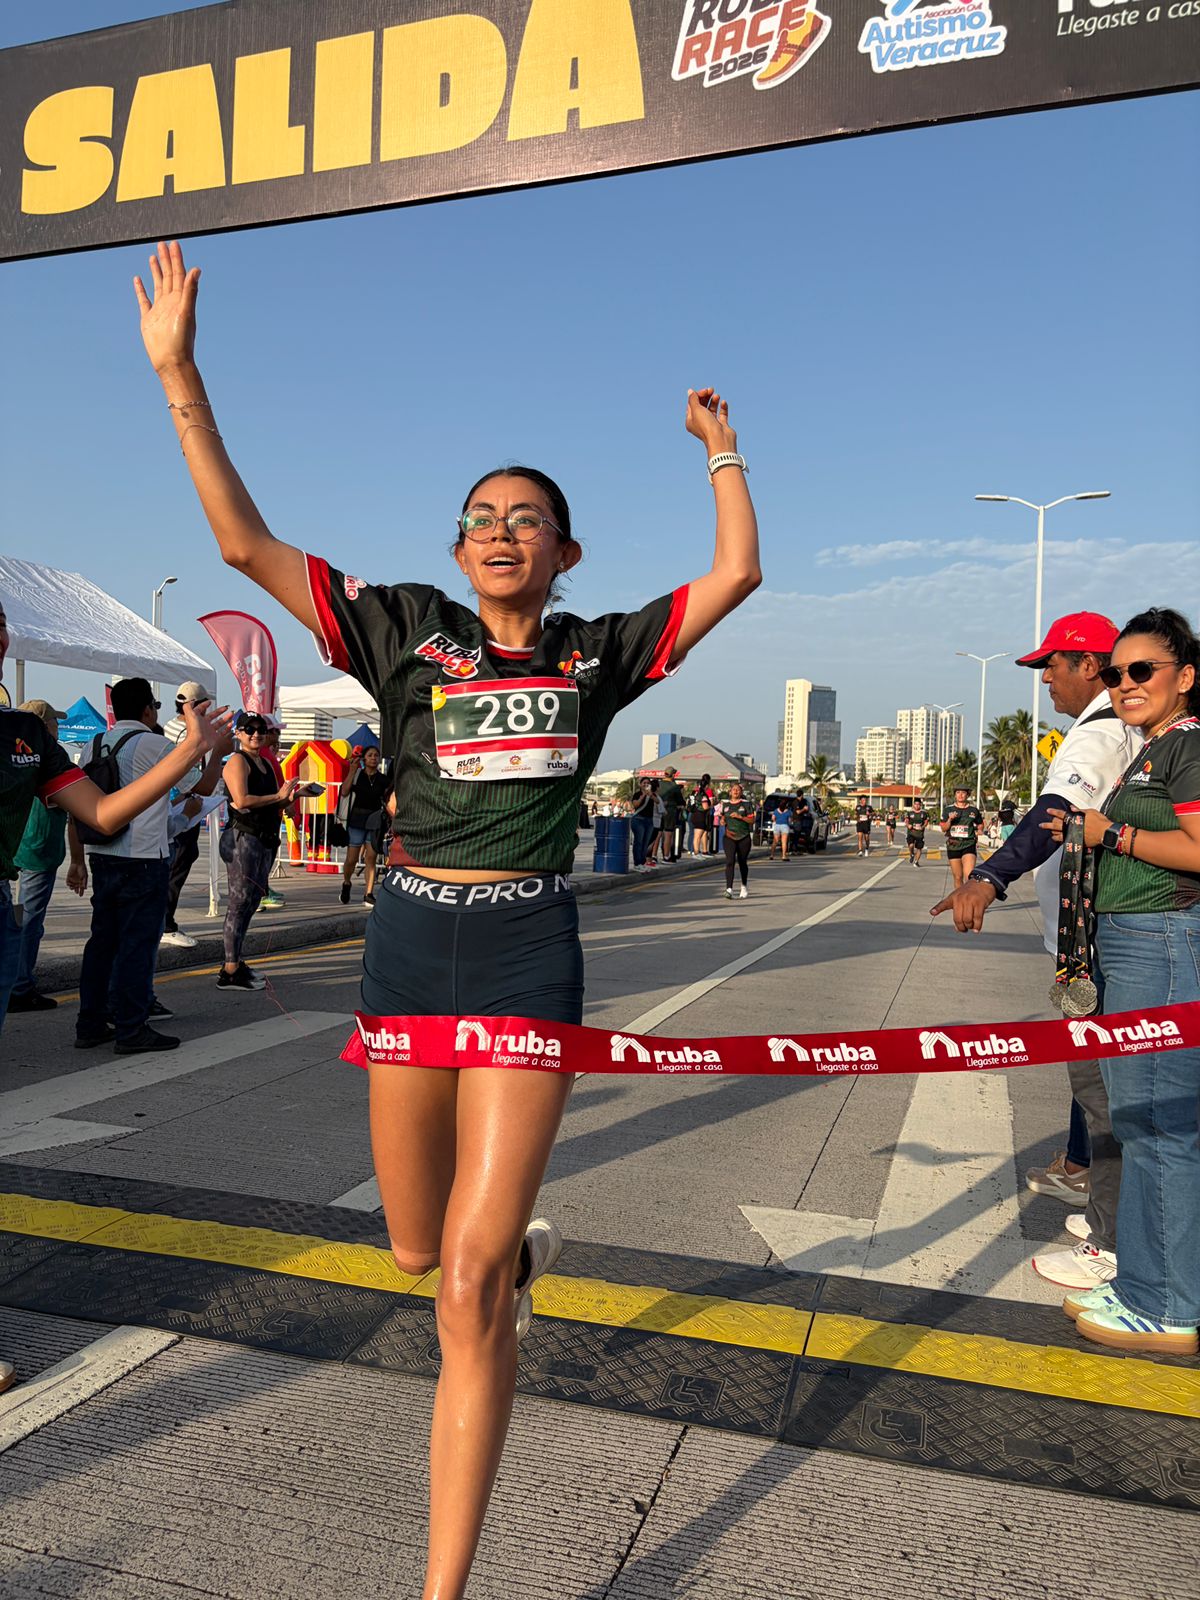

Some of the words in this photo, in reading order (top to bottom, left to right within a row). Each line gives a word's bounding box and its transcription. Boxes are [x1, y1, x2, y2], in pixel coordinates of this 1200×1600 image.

[686, 0, 780, 37] RU
[864, 11, 987, 47] Autismo
[1057, 9, 1140, 37] Llegaste
[1146, 6, 1161, 22] a
[1167, 0, 1200, 19] cas
[678, 0, 808, 75] RACE
[875, 32, 1000, 67] Veracruz
[708, 45, 769, 82] 2026
[21, 0, 644, 215] SALIDA
[428, 635, 480, 661] RUBA
[475, 692, 560, 735] 289
[11, 754, 40, 763] ruba
[457, 756, 481, 768] RUBA
[547, 760, 569, 769] ruba
[391, 871, 464, 905] NIKE
[465, 878, 543, 905] PRO
[366, 1028, 410, 1050] ruba
[1112, 1019, 1180, 1042] ruba
[494, 1030, 561, 1057] ruba
[653, 1046, 721, 1063] ruba
[811, 1043, 876, 1062] ruba
[962, 1034, 1026, 1057] ruba
[1119, 1041, 1153, 1052] Llegaste
[1164, 1038, 1184, 1046] casa
[387, 1053, 393, 1061] a
[394, 1053, 411, 1061] casa
[492, 1053, 529, 1066] Llegaste
[532, 1058, 538, 1066] a
[540, 1059, 561, 1068] casa
[657, 1064, 692, 1072] Llegaste
[816, 1063, 850, 1073] Llegaste
[860, 1063, 879, 1071] casa
[966, 1057, 1000, 1068] Llegaste
[1010, 1054, 1029, 1062] casa
